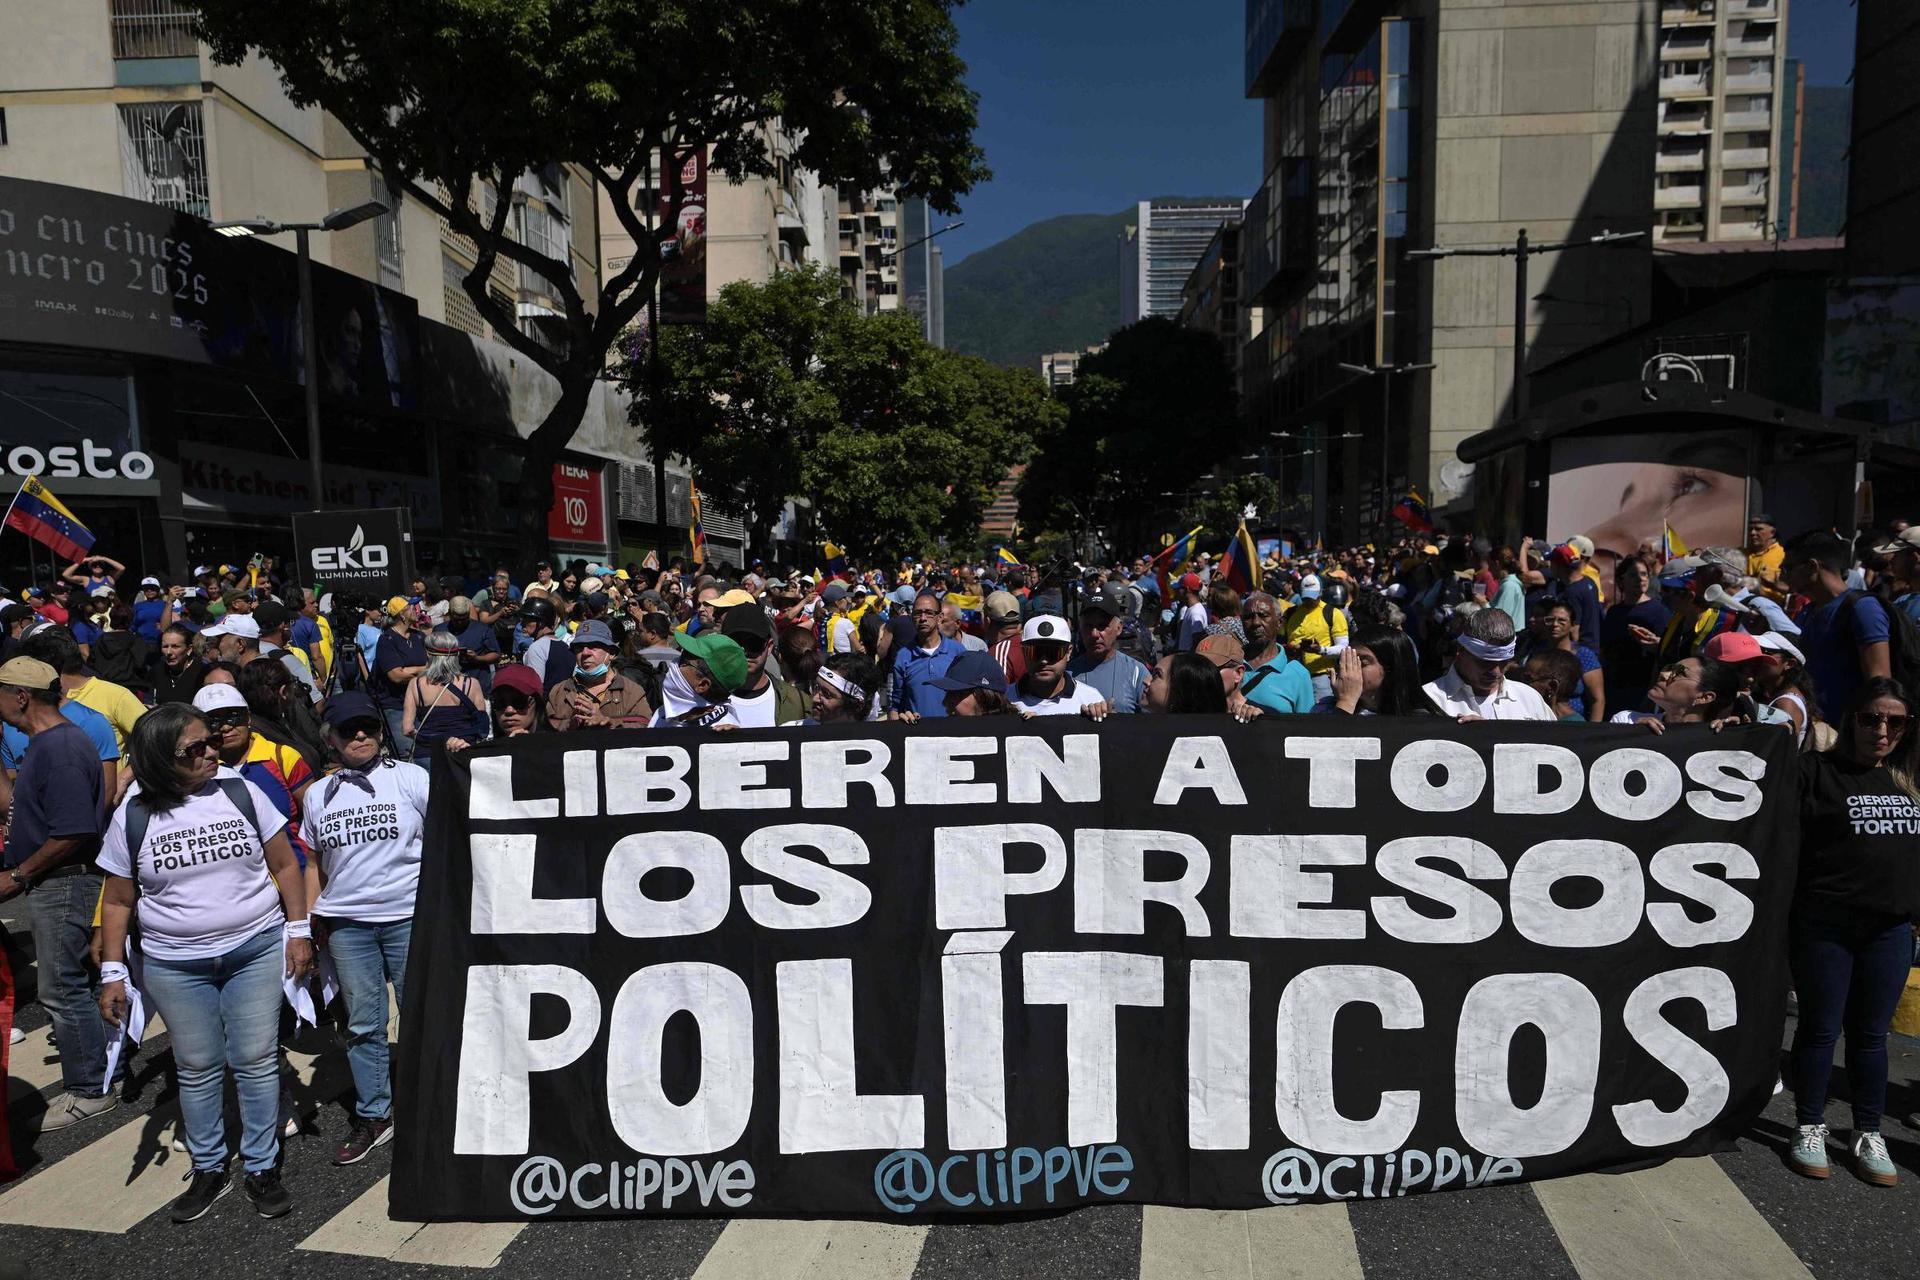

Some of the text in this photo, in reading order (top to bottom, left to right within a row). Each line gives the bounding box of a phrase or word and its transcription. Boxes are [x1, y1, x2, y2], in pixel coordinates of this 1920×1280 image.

[37, 214, 86, 246] en
[104, 221, 193, 267] cines
[126, 258, 209, 305] 2026
[35, 299, 78, 312] IMAX
[0, 438, 155, 480] osto
[563, 497, 588, 527] 100
[311, 545, 389, 570] EKO
[315, 569, 389, 580] ILUMINACIÓN
[469, 734, 1767, 821] LIBEREN A TODOS
[320, 803, 397, 824] LIBEREN A TODOS
[1846, 795, 1911, 806] CIERREN
[1848, 806, 1920, 819] CENTROS
[150, 818, 244, 846] LIBEREN A TODOS
[320, 813, 397, 837] LOS PRESOS
[1850, 819, 1920, 835] TORTU
[152, 829, 248, 857] LOS PRESOS
[320, 826, 399, 855] POLÍTICOS
[153, 842, 253, 874] POLÍTICOS
[470, 823, 1761, 949] LOS PRESOS
[454, 930, 1738, 1166] POLÍTICOS
